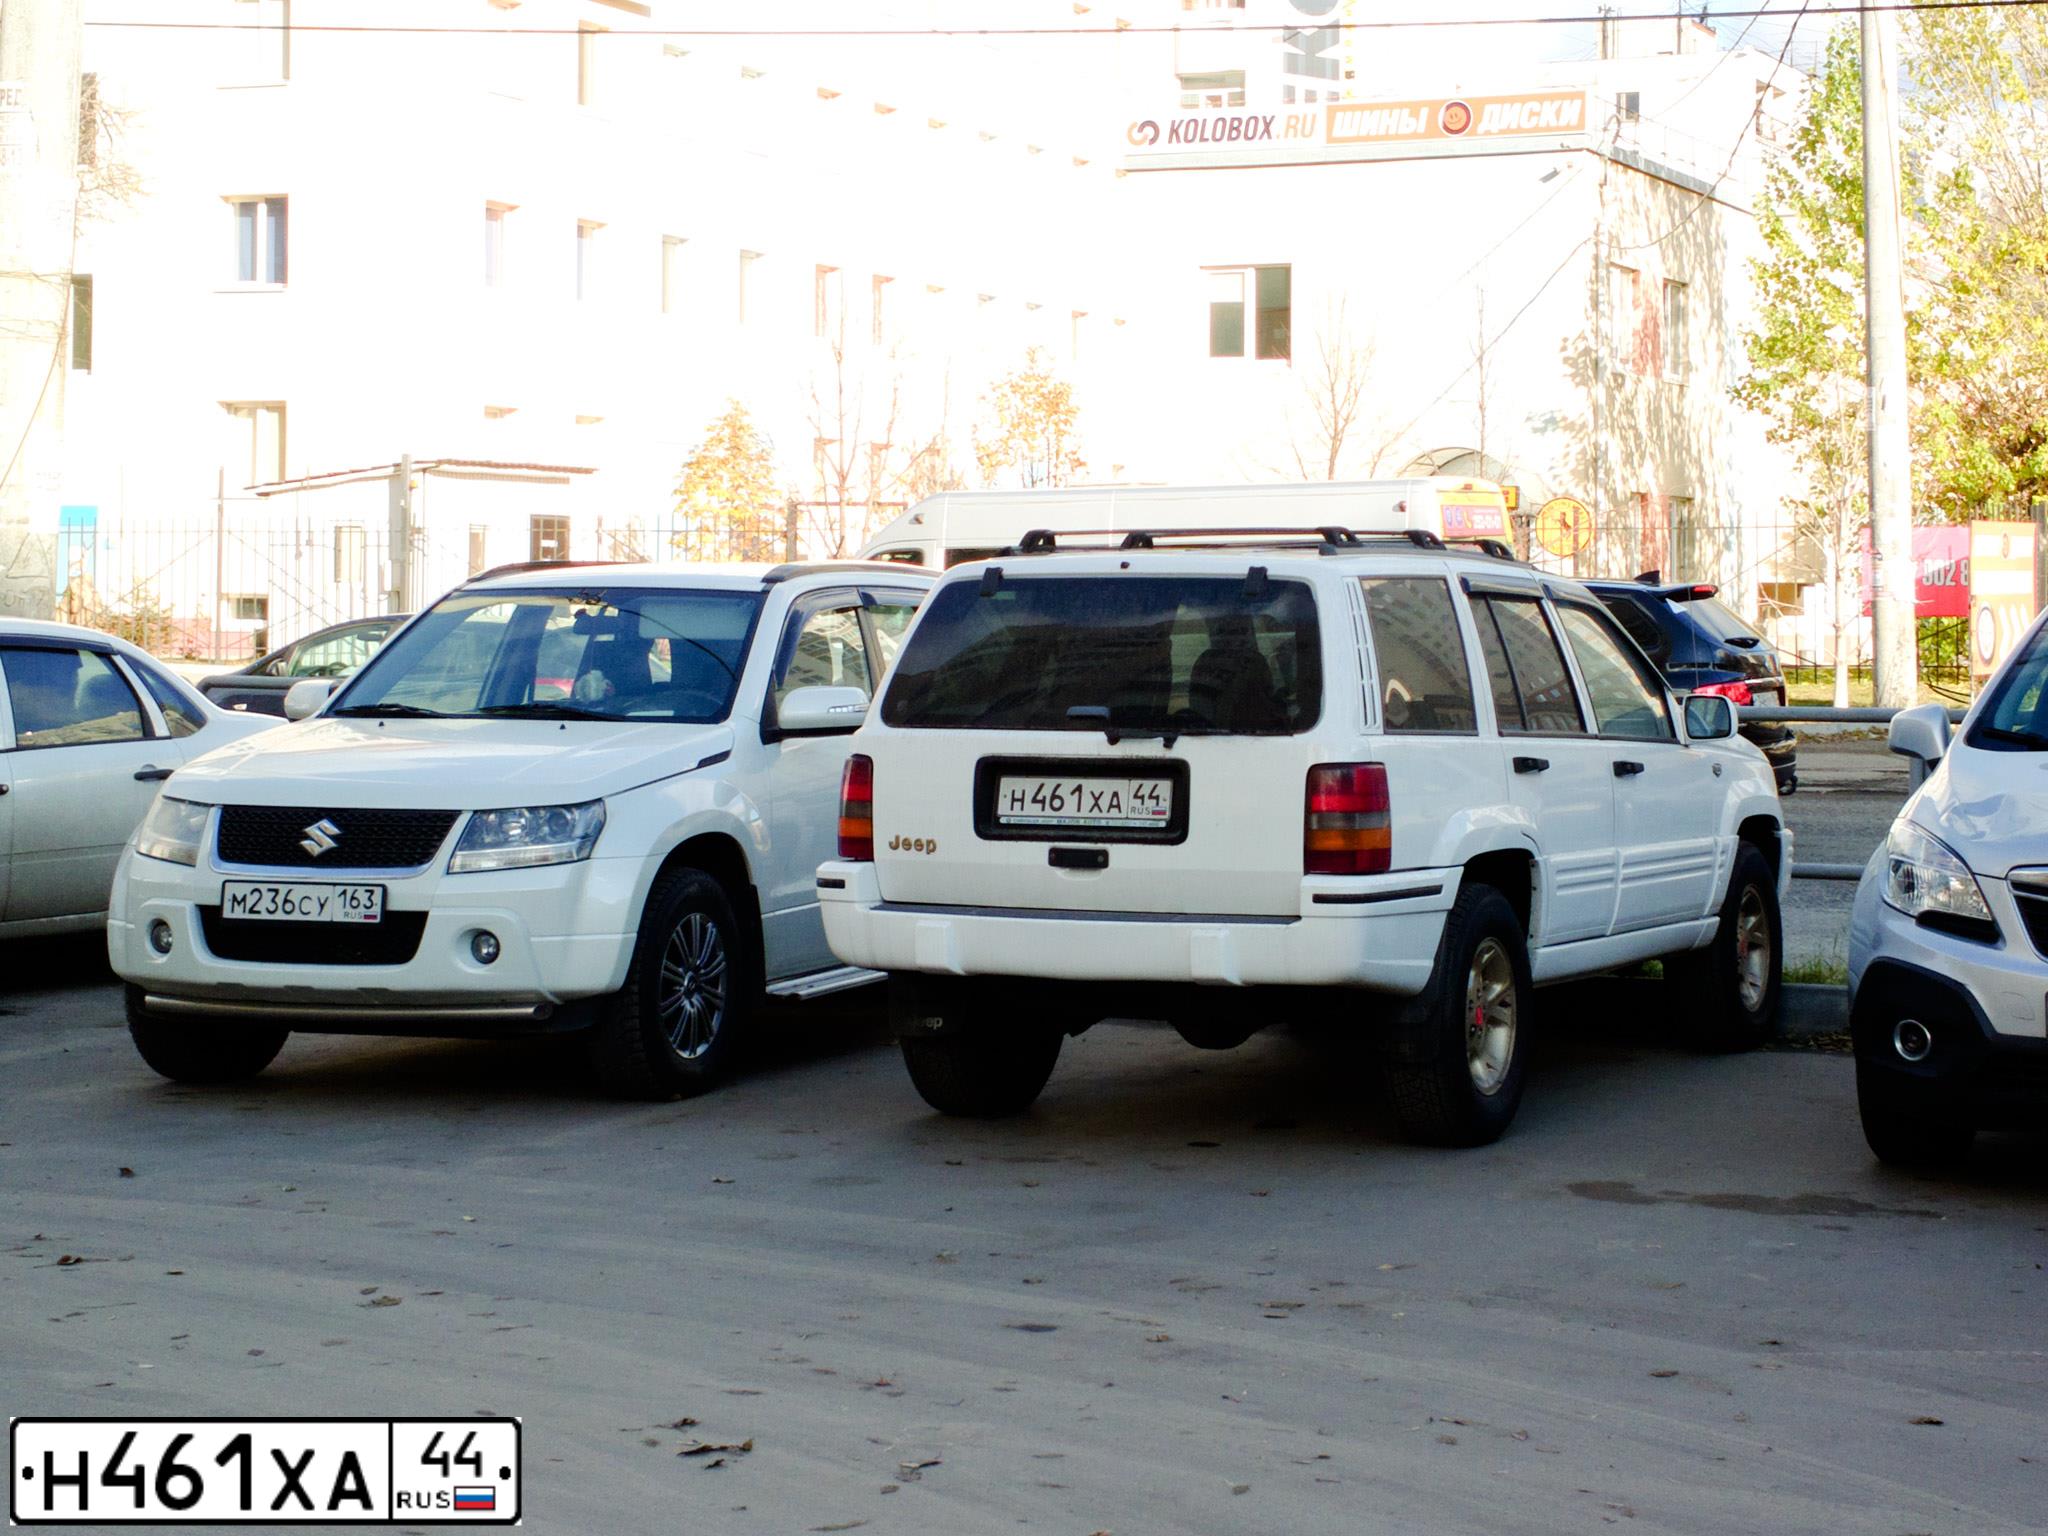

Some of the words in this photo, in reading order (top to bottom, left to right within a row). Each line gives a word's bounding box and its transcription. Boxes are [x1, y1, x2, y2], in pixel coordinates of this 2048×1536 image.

[1167, 112, 1317, 144] KOLOBOX.RU
[1332, 107, 1429, 138] ШИНЫ
[1477, 99, 1582, 134] ДИСКИ
[1922, 559, 1956, 586] 902
[1133, 783, 1160, 807] 44
[1130, 807, 1150, 816] RUS
[888, 834, 938, 855] Jeep
[337, 889, 376, 910] 163
[343, 911, 363, 919] RUS
